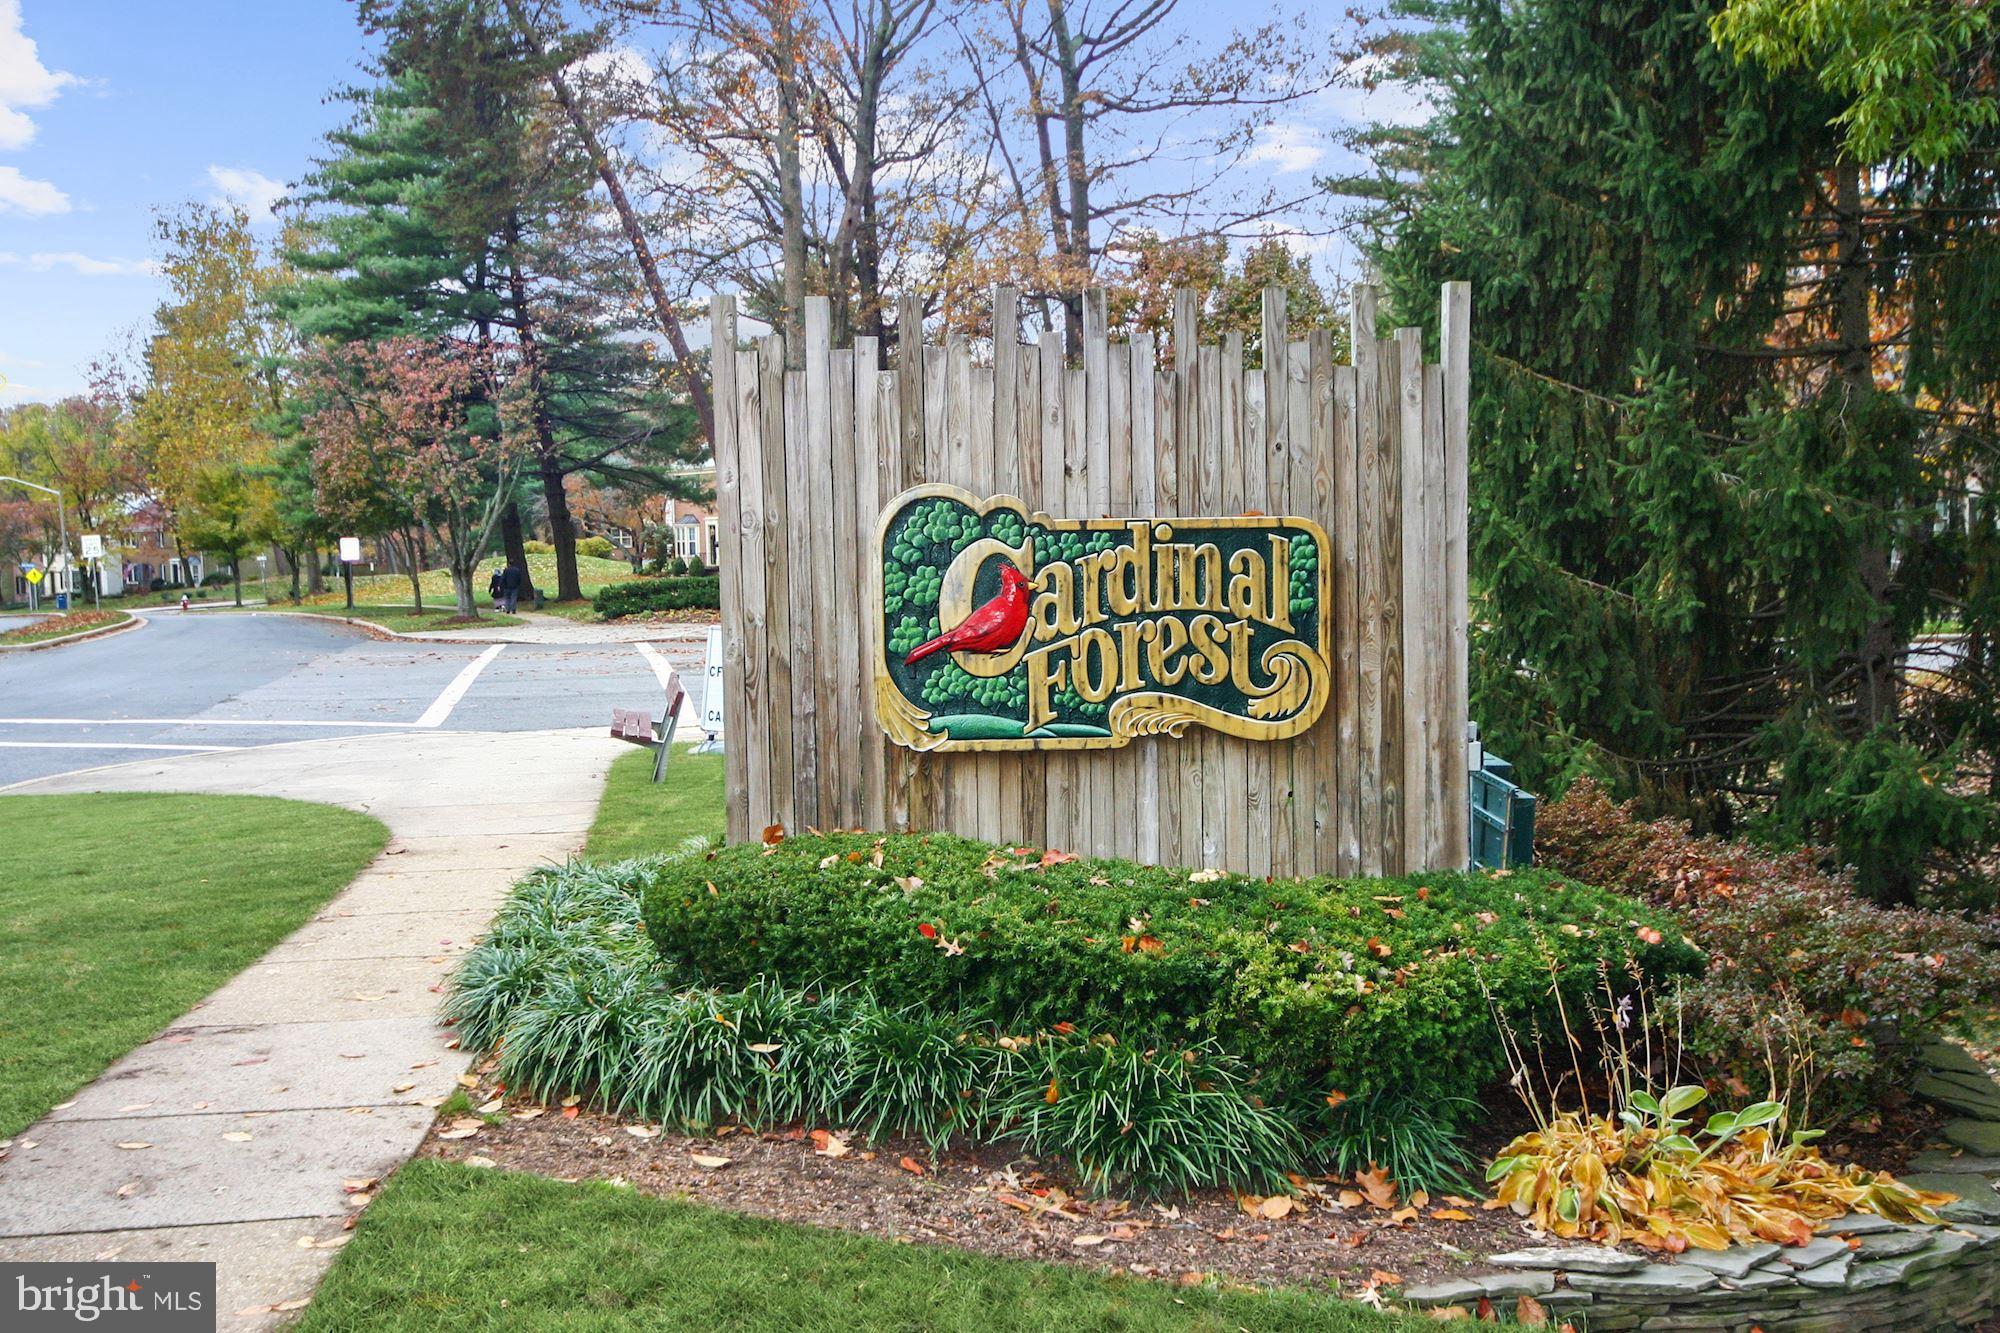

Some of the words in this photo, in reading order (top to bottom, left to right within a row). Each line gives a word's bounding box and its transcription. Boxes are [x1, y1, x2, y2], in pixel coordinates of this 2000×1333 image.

[85, 546, 100, 555] 25
[939, 521, 1296, 677] Cardinal
[1023, 614, 1281, 735] Forest
